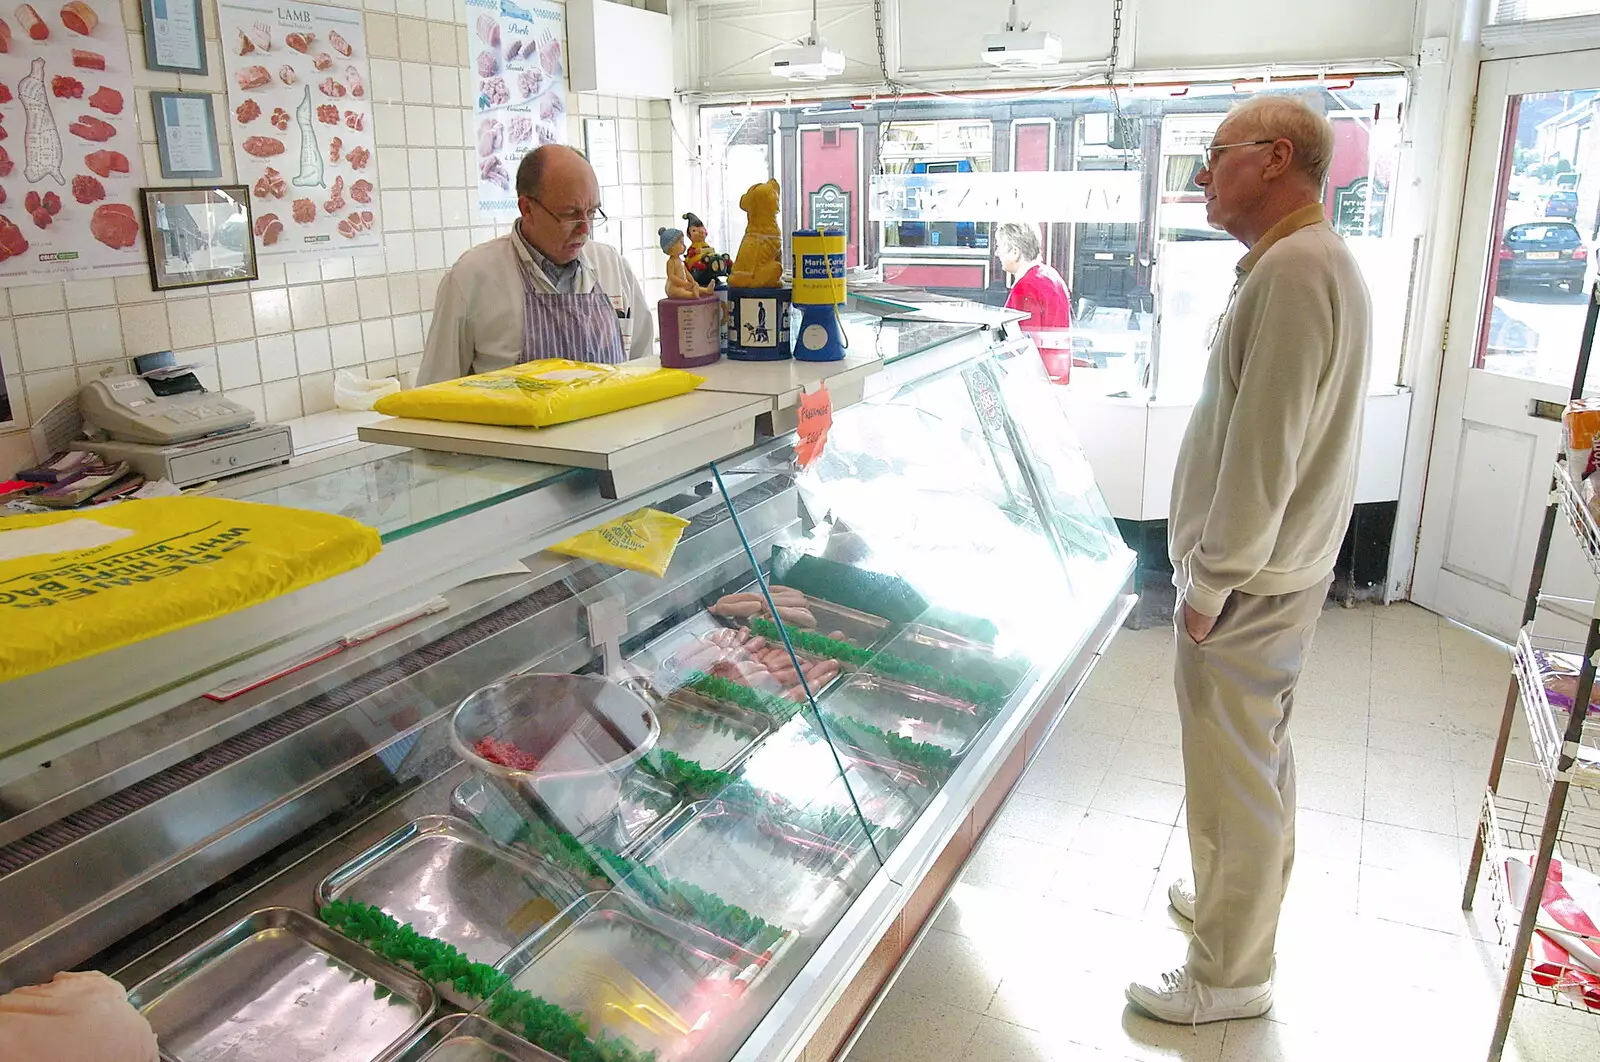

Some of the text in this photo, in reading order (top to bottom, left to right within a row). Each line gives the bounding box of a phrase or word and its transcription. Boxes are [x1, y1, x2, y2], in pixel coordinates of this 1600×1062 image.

[277, 7, 311, 22] LAMB
[507, 23, 529, 36] Pork
[804, 258, 845, 266] Marie Curie
[804, 267, 828, 275] Cance
[155, 527, 252, 564] WHITE
[101, 544, 174, 570] WITH
[11, 540, 252, 610] PREMIER
[66, 560, 159, 584] HOPE
